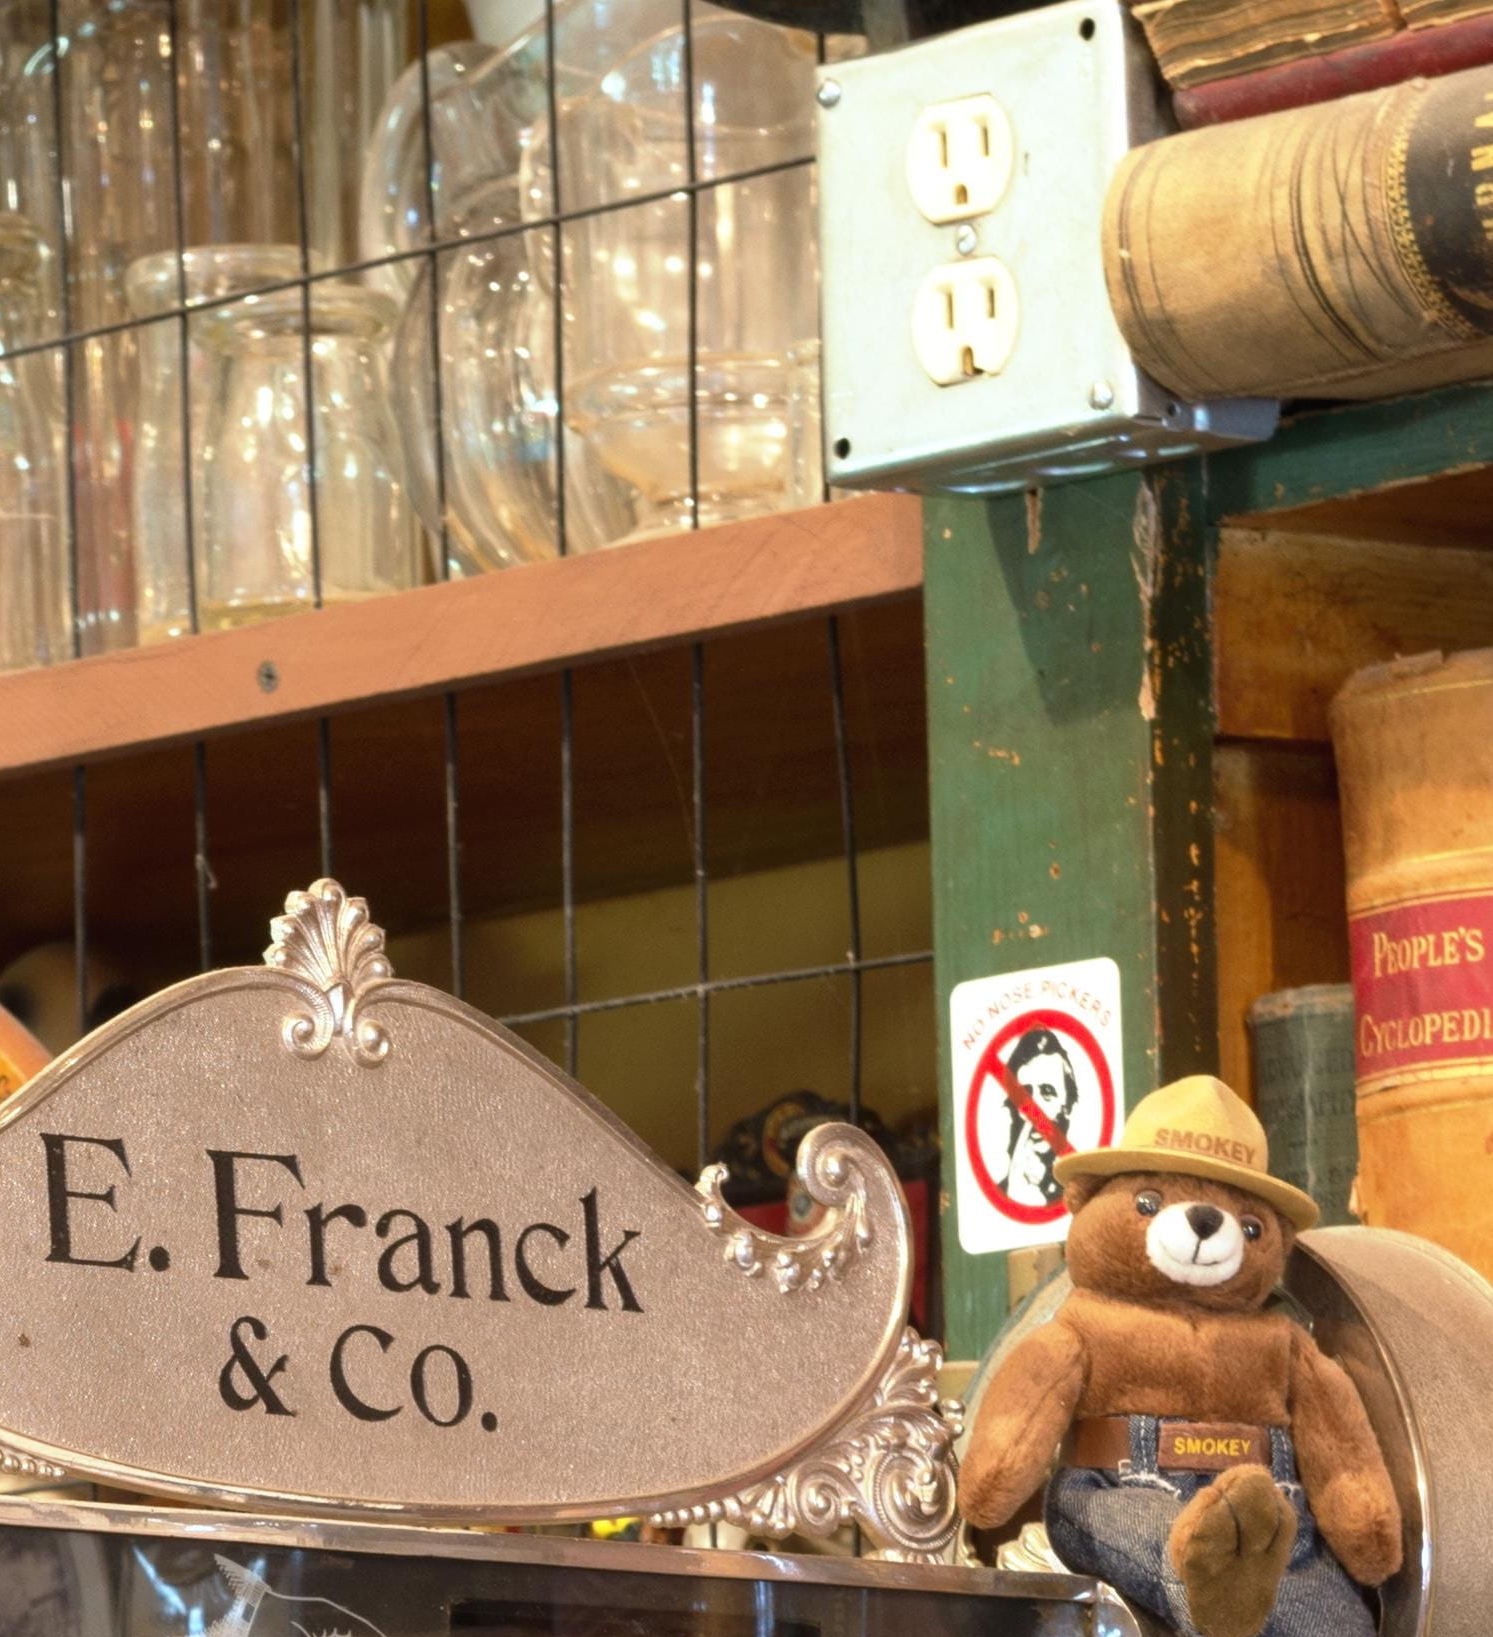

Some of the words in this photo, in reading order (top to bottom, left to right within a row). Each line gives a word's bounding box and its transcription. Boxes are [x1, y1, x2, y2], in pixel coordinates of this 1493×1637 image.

[1373, 927, 1485, 978] PEOPLE'S
[963, 1020, 986, 1051] NO
[987, 983, 1032, 1017] NOSE
[1040, 980, 1112, 1028] PICKERS
[1154, 1127, 1256, 1165] SMOKEY
[39, 1132, 171, 1273] E.
[205, 1148, 645, 1313] Franck
[218, 1315, 298, 1418] &
[329, 1323, 498, 1433] Co.
[1172, 1434, 1254, 1459] SMOKEY
